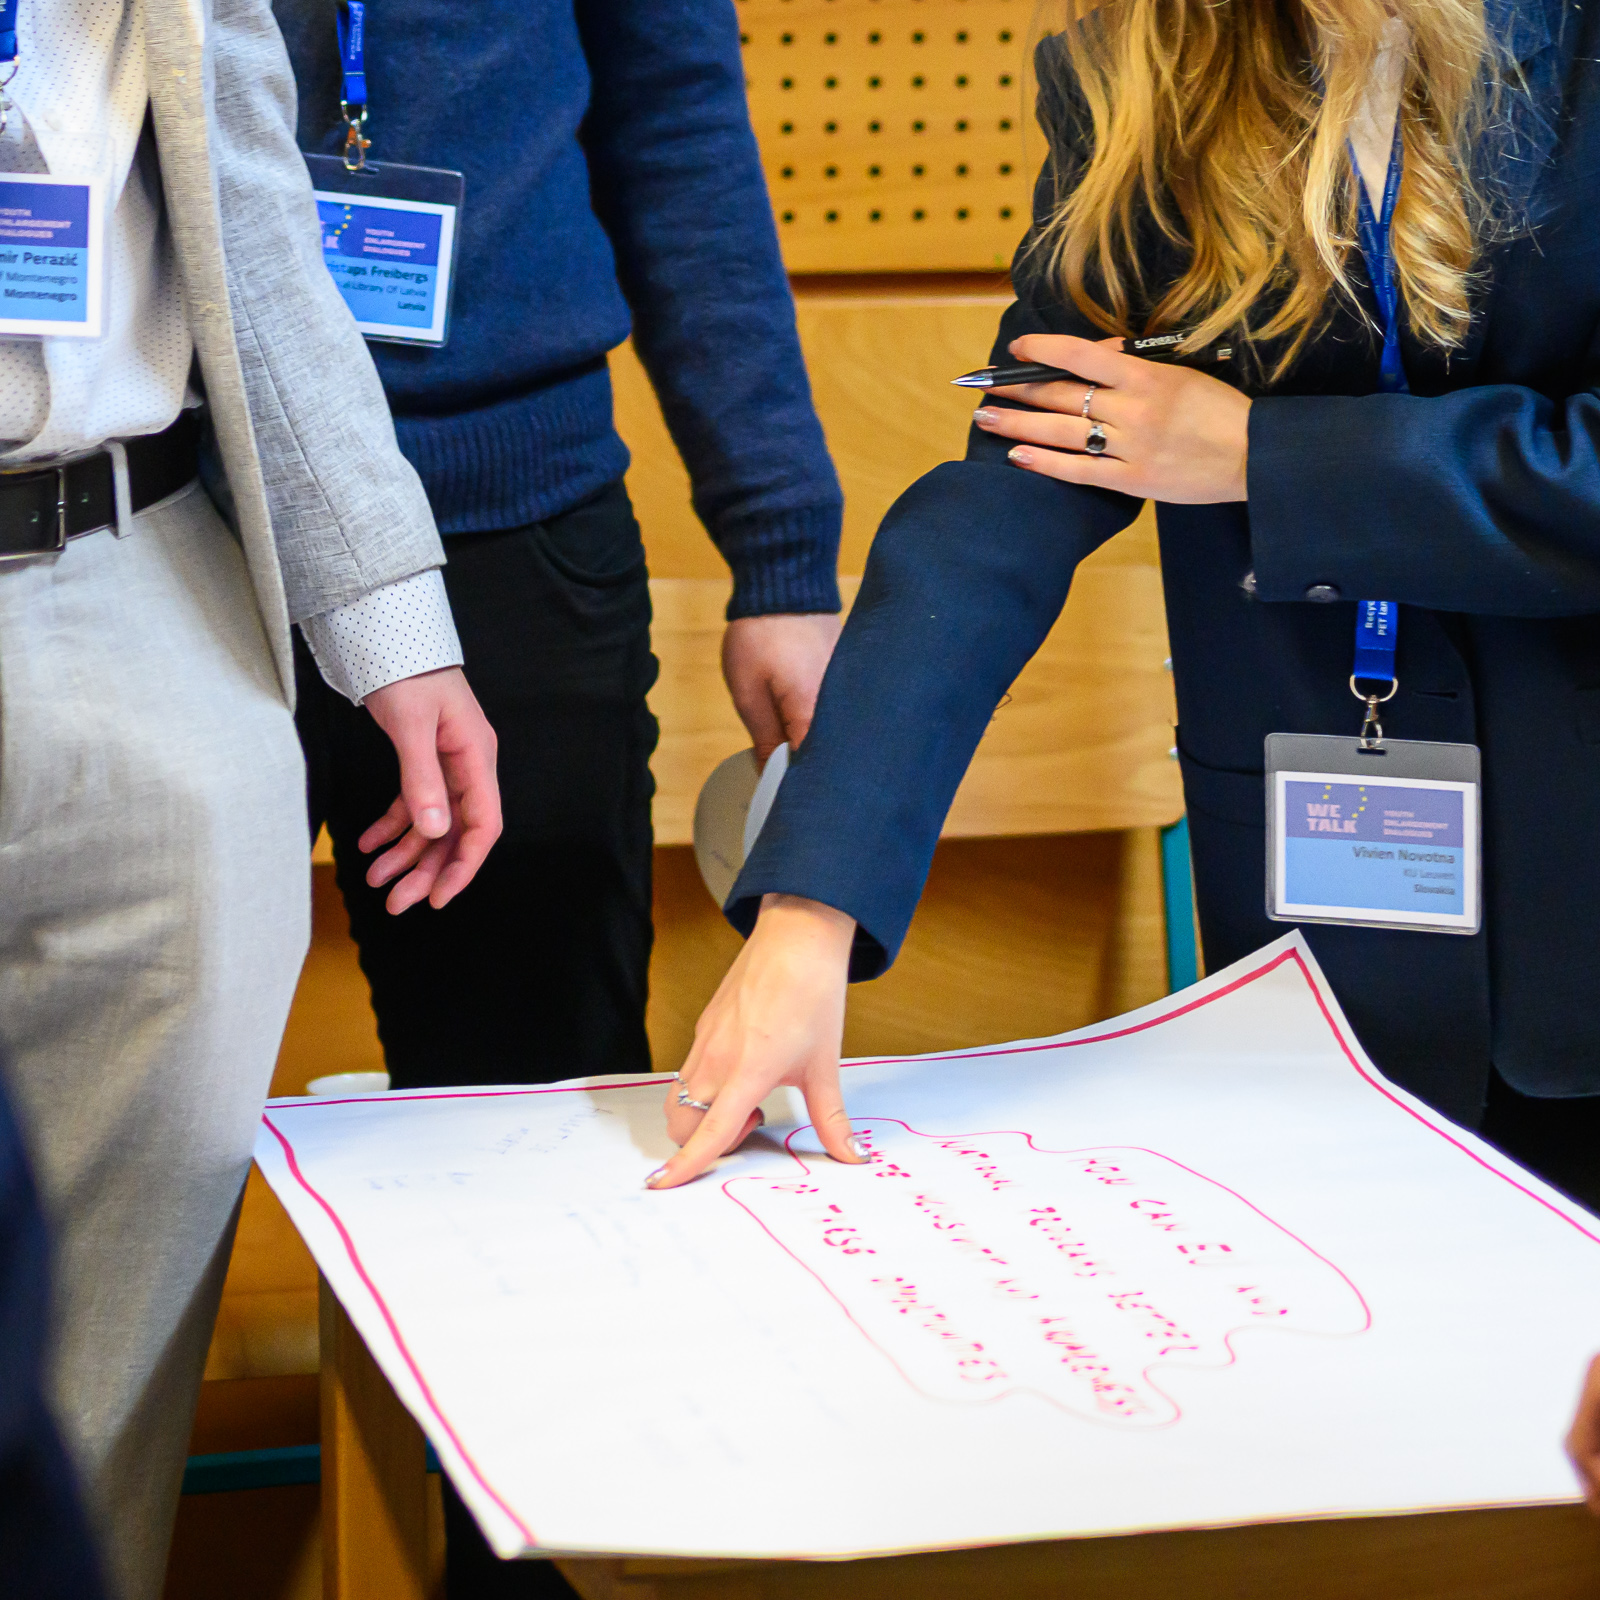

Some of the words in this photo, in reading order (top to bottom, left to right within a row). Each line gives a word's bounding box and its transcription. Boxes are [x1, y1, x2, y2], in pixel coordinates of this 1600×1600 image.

[1306, 802, 1341, 819] WE
[1306, 817, 1357, 834] TALK
[1129, 1199, 1182, 1232] CAN
